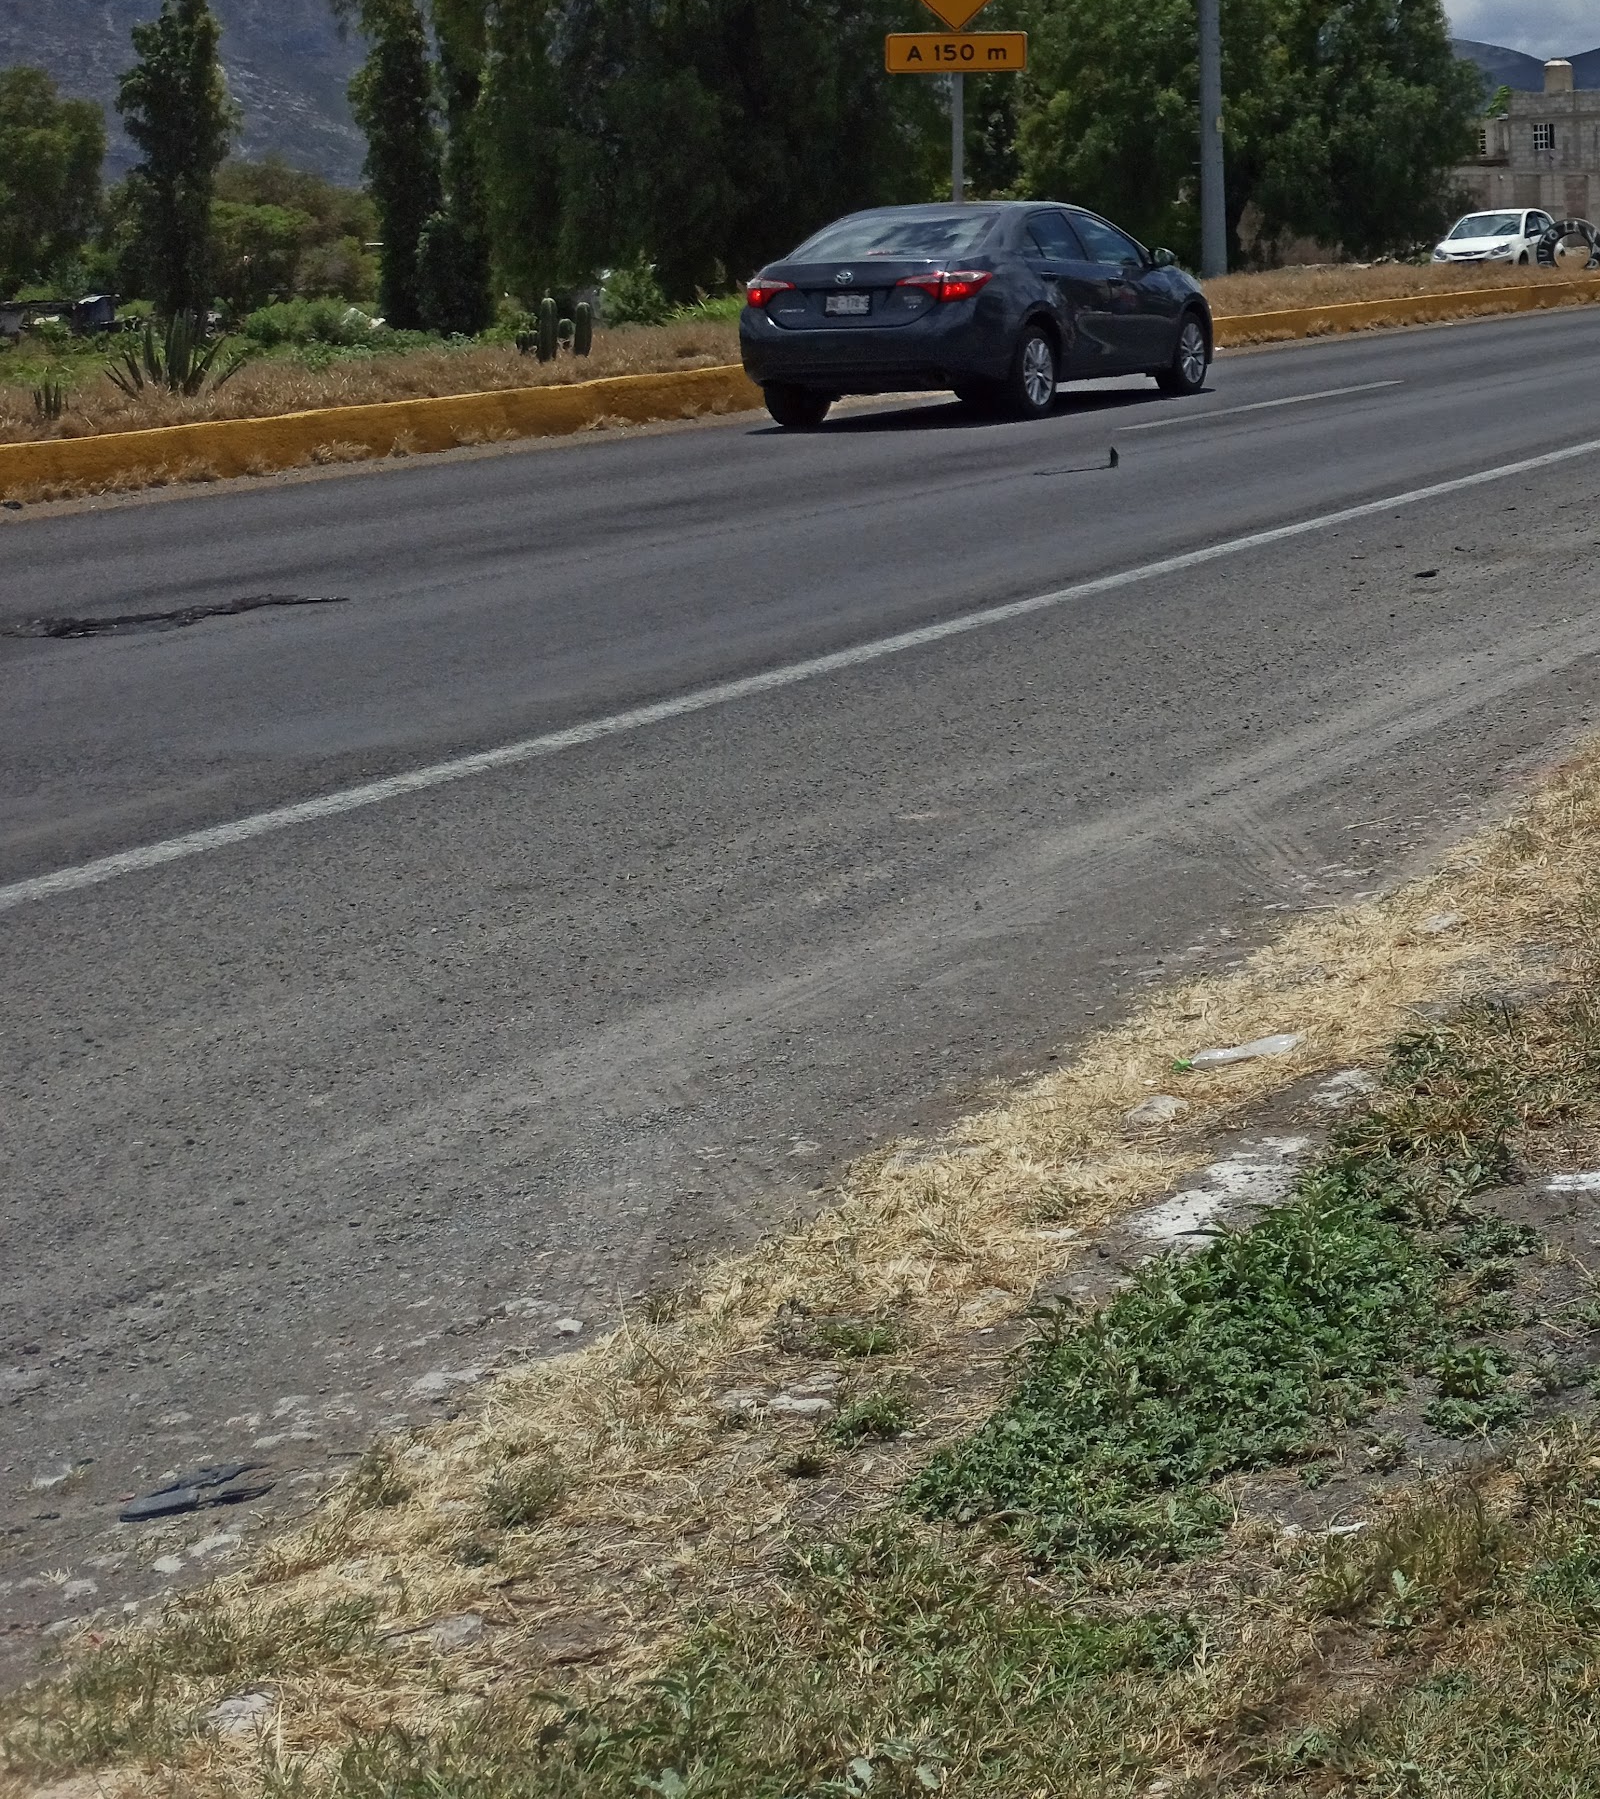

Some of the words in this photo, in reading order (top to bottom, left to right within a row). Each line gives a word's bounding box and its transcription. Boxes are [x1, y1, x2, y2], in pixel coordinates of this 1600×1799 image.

[906, 45, 923, 62] A
[933, 43, 975, 62] 150
[987, 47, 1008, 62] m
